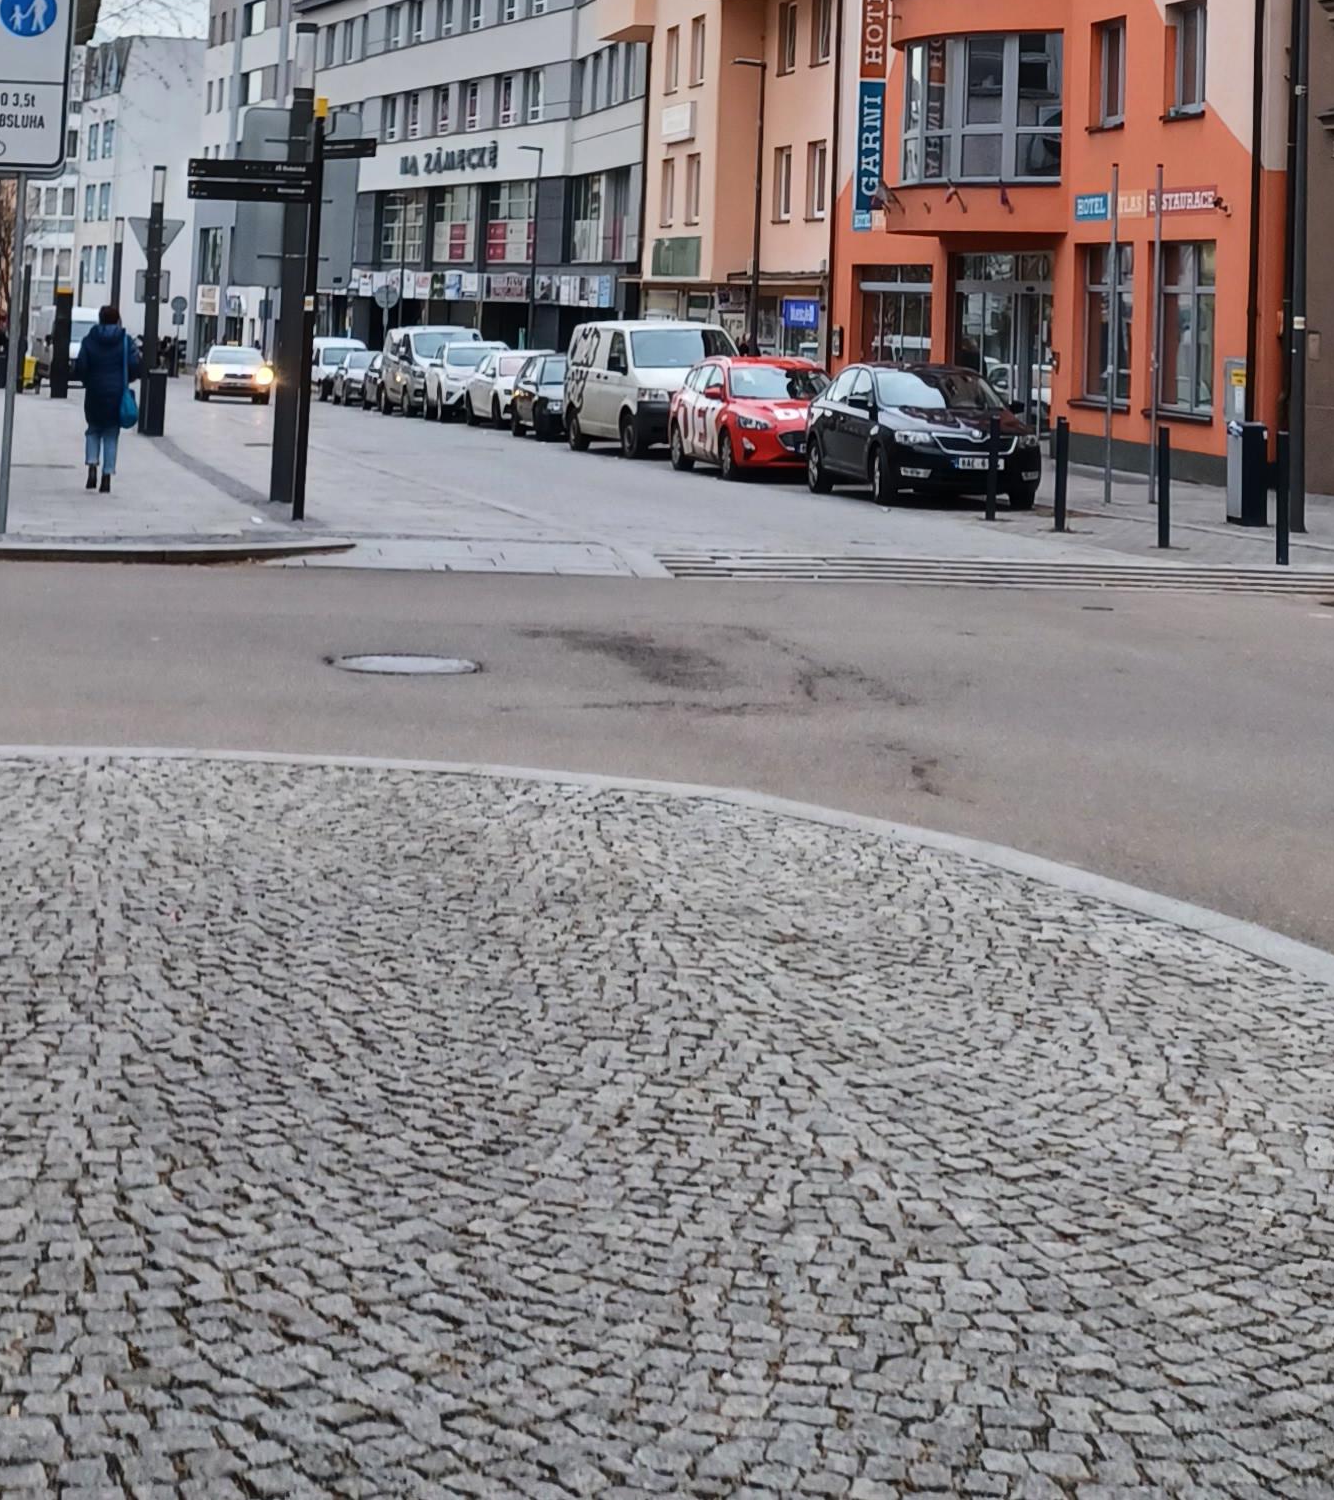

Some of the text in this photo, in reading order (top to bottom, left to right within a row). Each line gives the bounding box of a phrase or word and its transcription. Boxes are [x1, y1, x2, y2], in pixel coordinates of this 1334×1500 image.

[860, 95, 882, 198] GARNI
[1076, 198, 1106, 216] HOTEL
[1149, 190, 1216, 212] RSTAURACE
